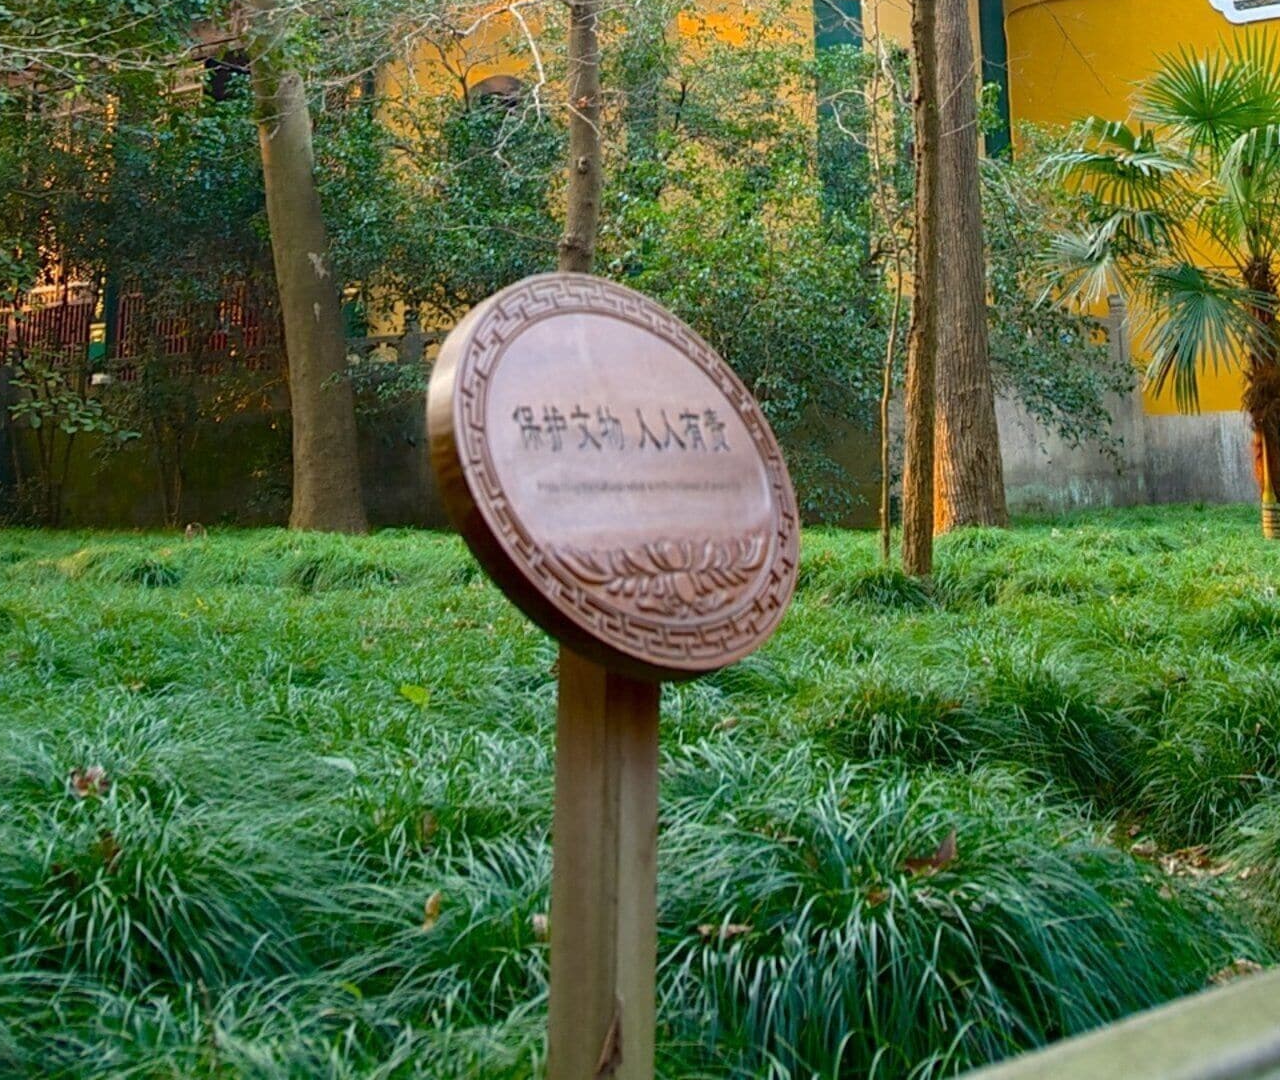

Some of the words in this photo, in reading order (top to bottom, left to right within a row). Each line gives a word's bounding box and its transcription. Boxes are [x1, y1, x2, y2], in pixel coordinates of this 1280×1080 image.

[512, 404, 625, 453] 保护文物
[634, 406, 731, 453] 人人有责
